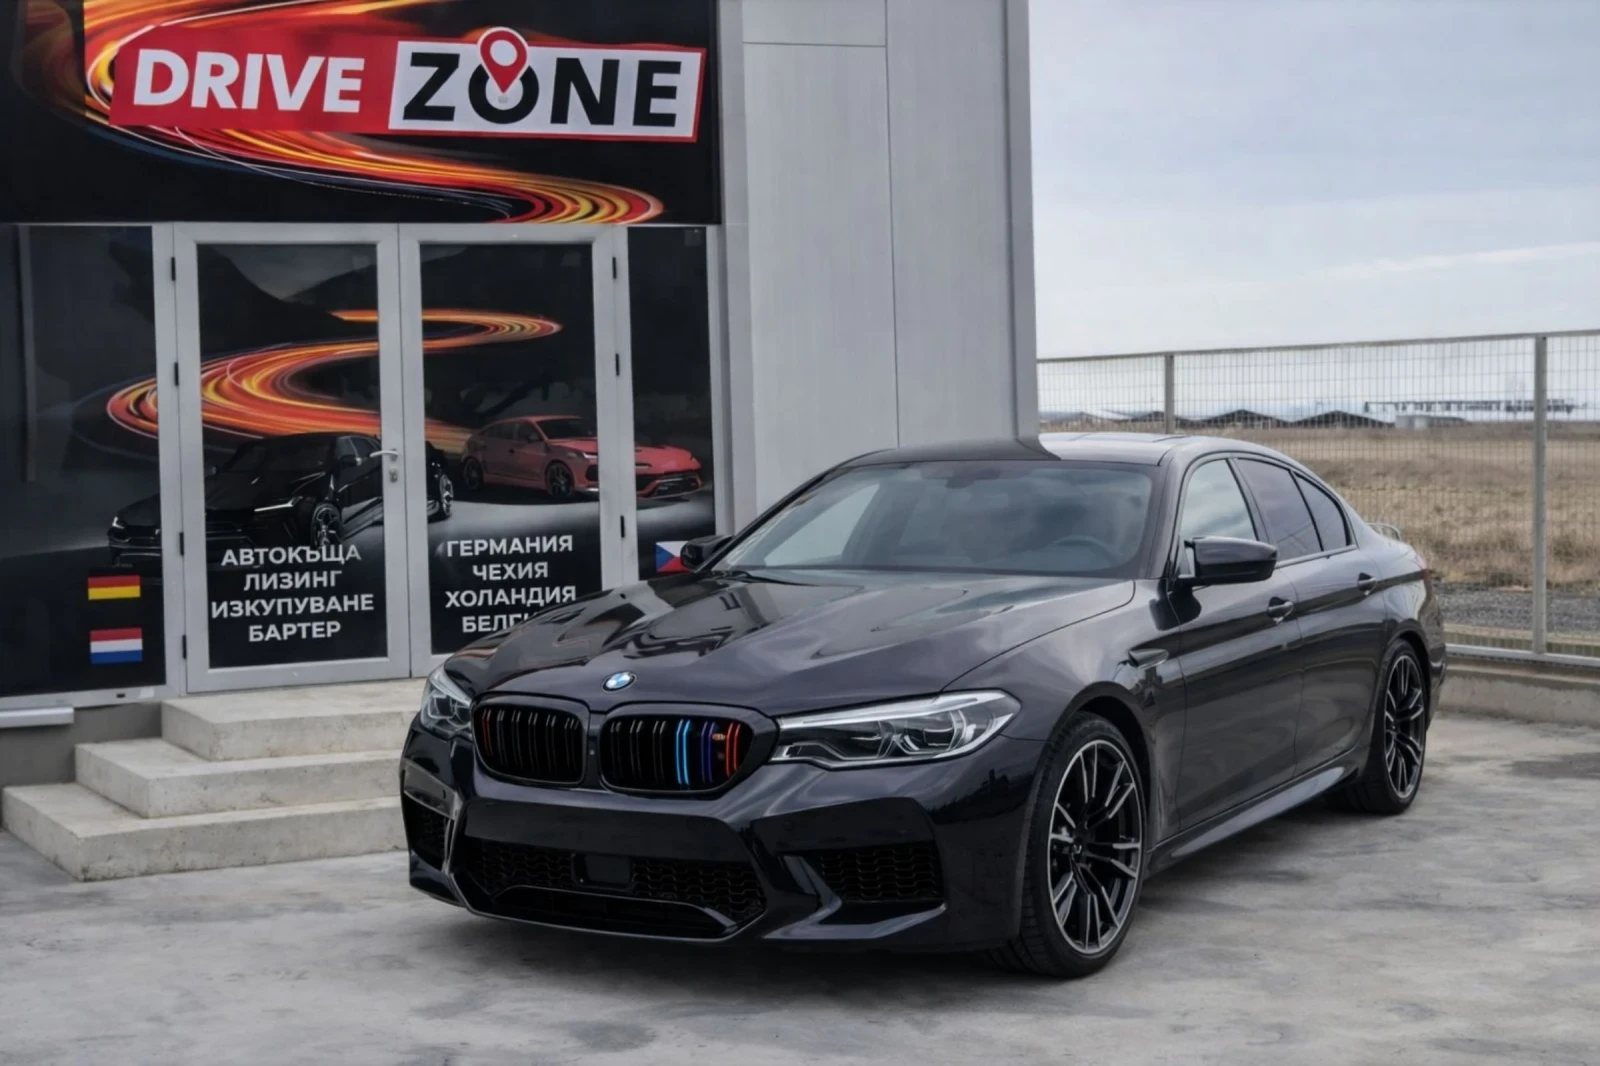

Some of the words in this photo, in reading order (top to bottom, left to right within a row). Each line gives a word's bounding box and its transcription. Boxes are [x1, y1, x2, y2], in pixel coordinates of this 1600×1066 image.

[133, 48, 365, 113] DRIVE
[402, 51, 683, 127] ZONE
[221, 544, 362, 566] АВТОКЪЩА
[447, 535, 573, 557] ГЕРМАНИЯ
[243, 570, 342, 591] ЛИЗИНГ
[472, 562, 549, 581] ЧЕХИЯ
[211, 593, 375, 619] ИЗКУПУВАНЕ
[445, 586, 576, 608] ХОЛАНДИЯ
[248, 620, 341, 642] БАРТЕР
